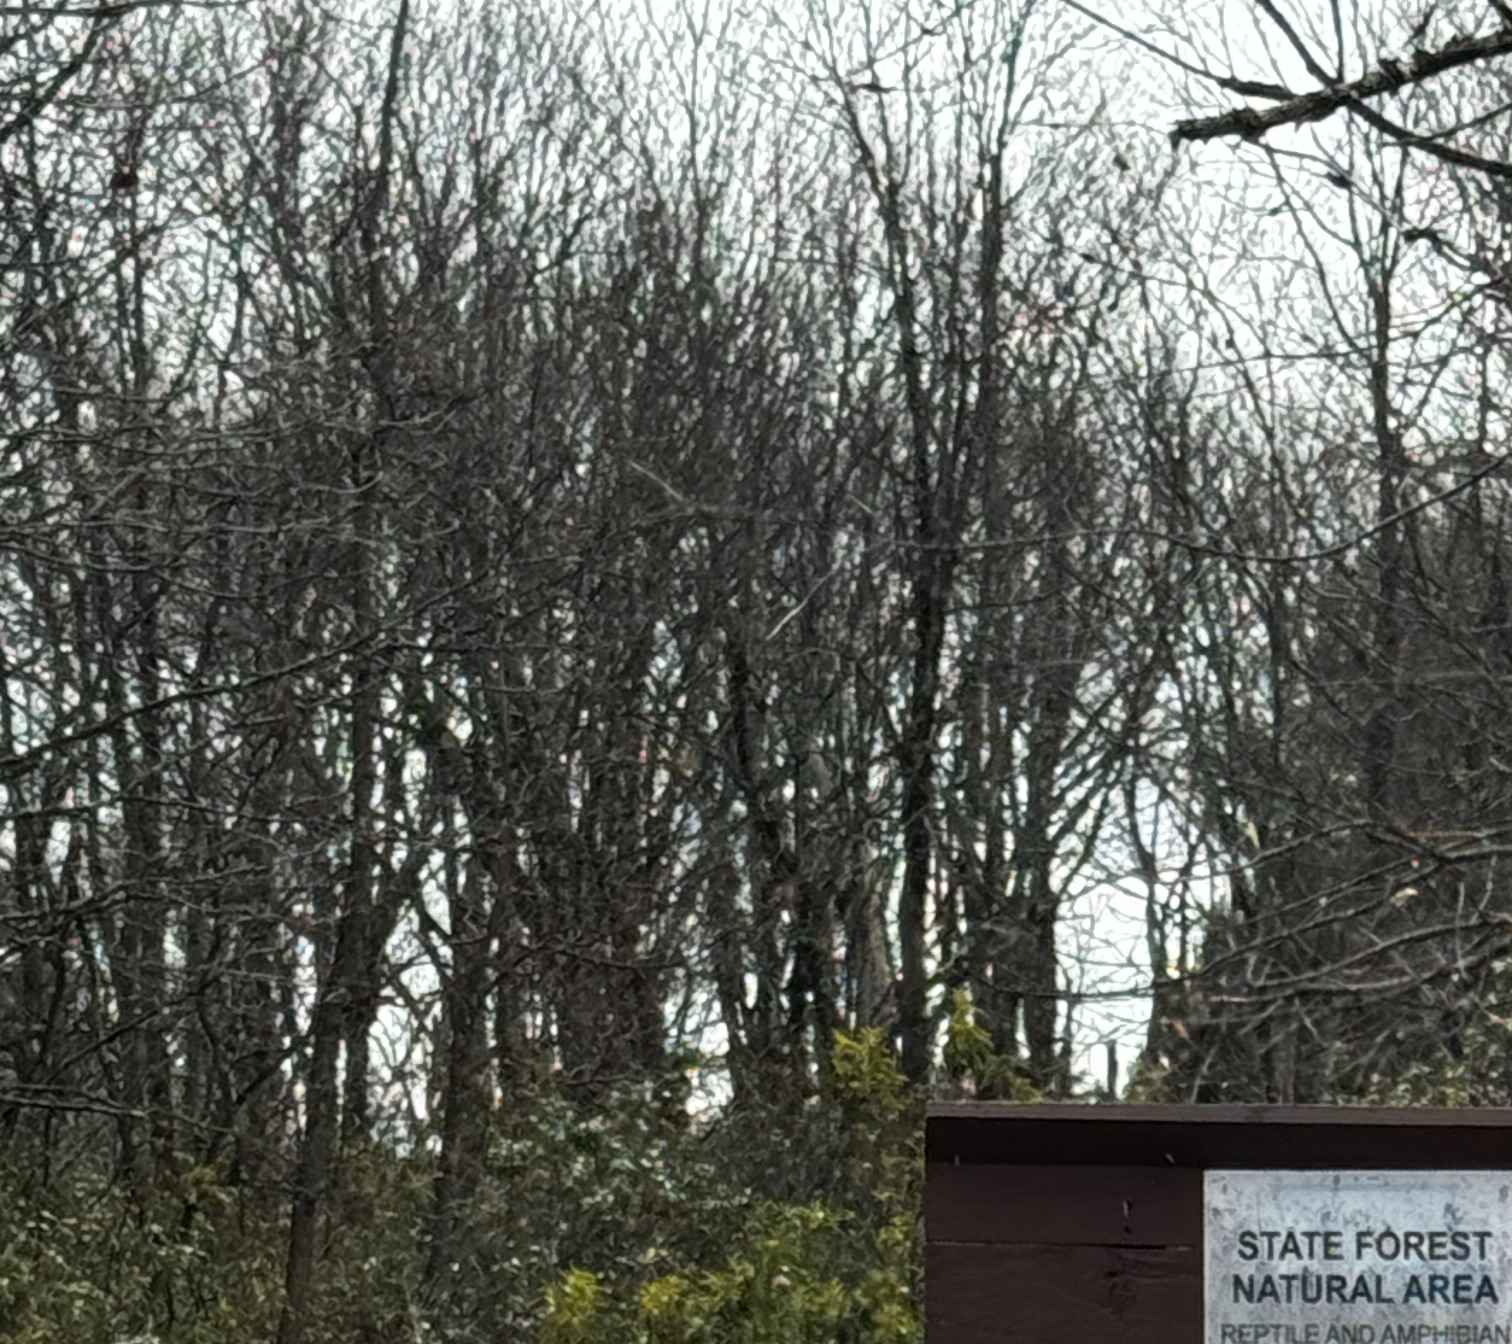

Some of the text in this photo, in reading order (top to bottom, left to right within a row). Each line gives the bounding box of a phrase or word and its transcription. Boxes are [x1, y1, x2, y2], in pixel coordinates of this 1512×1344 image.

[1237, 1230, 1492, 1261] STATE FOREST
[1232, 1273, 1499, 1304] NATURAL AREA
[1323, 1323, 1375, 1344] AND
